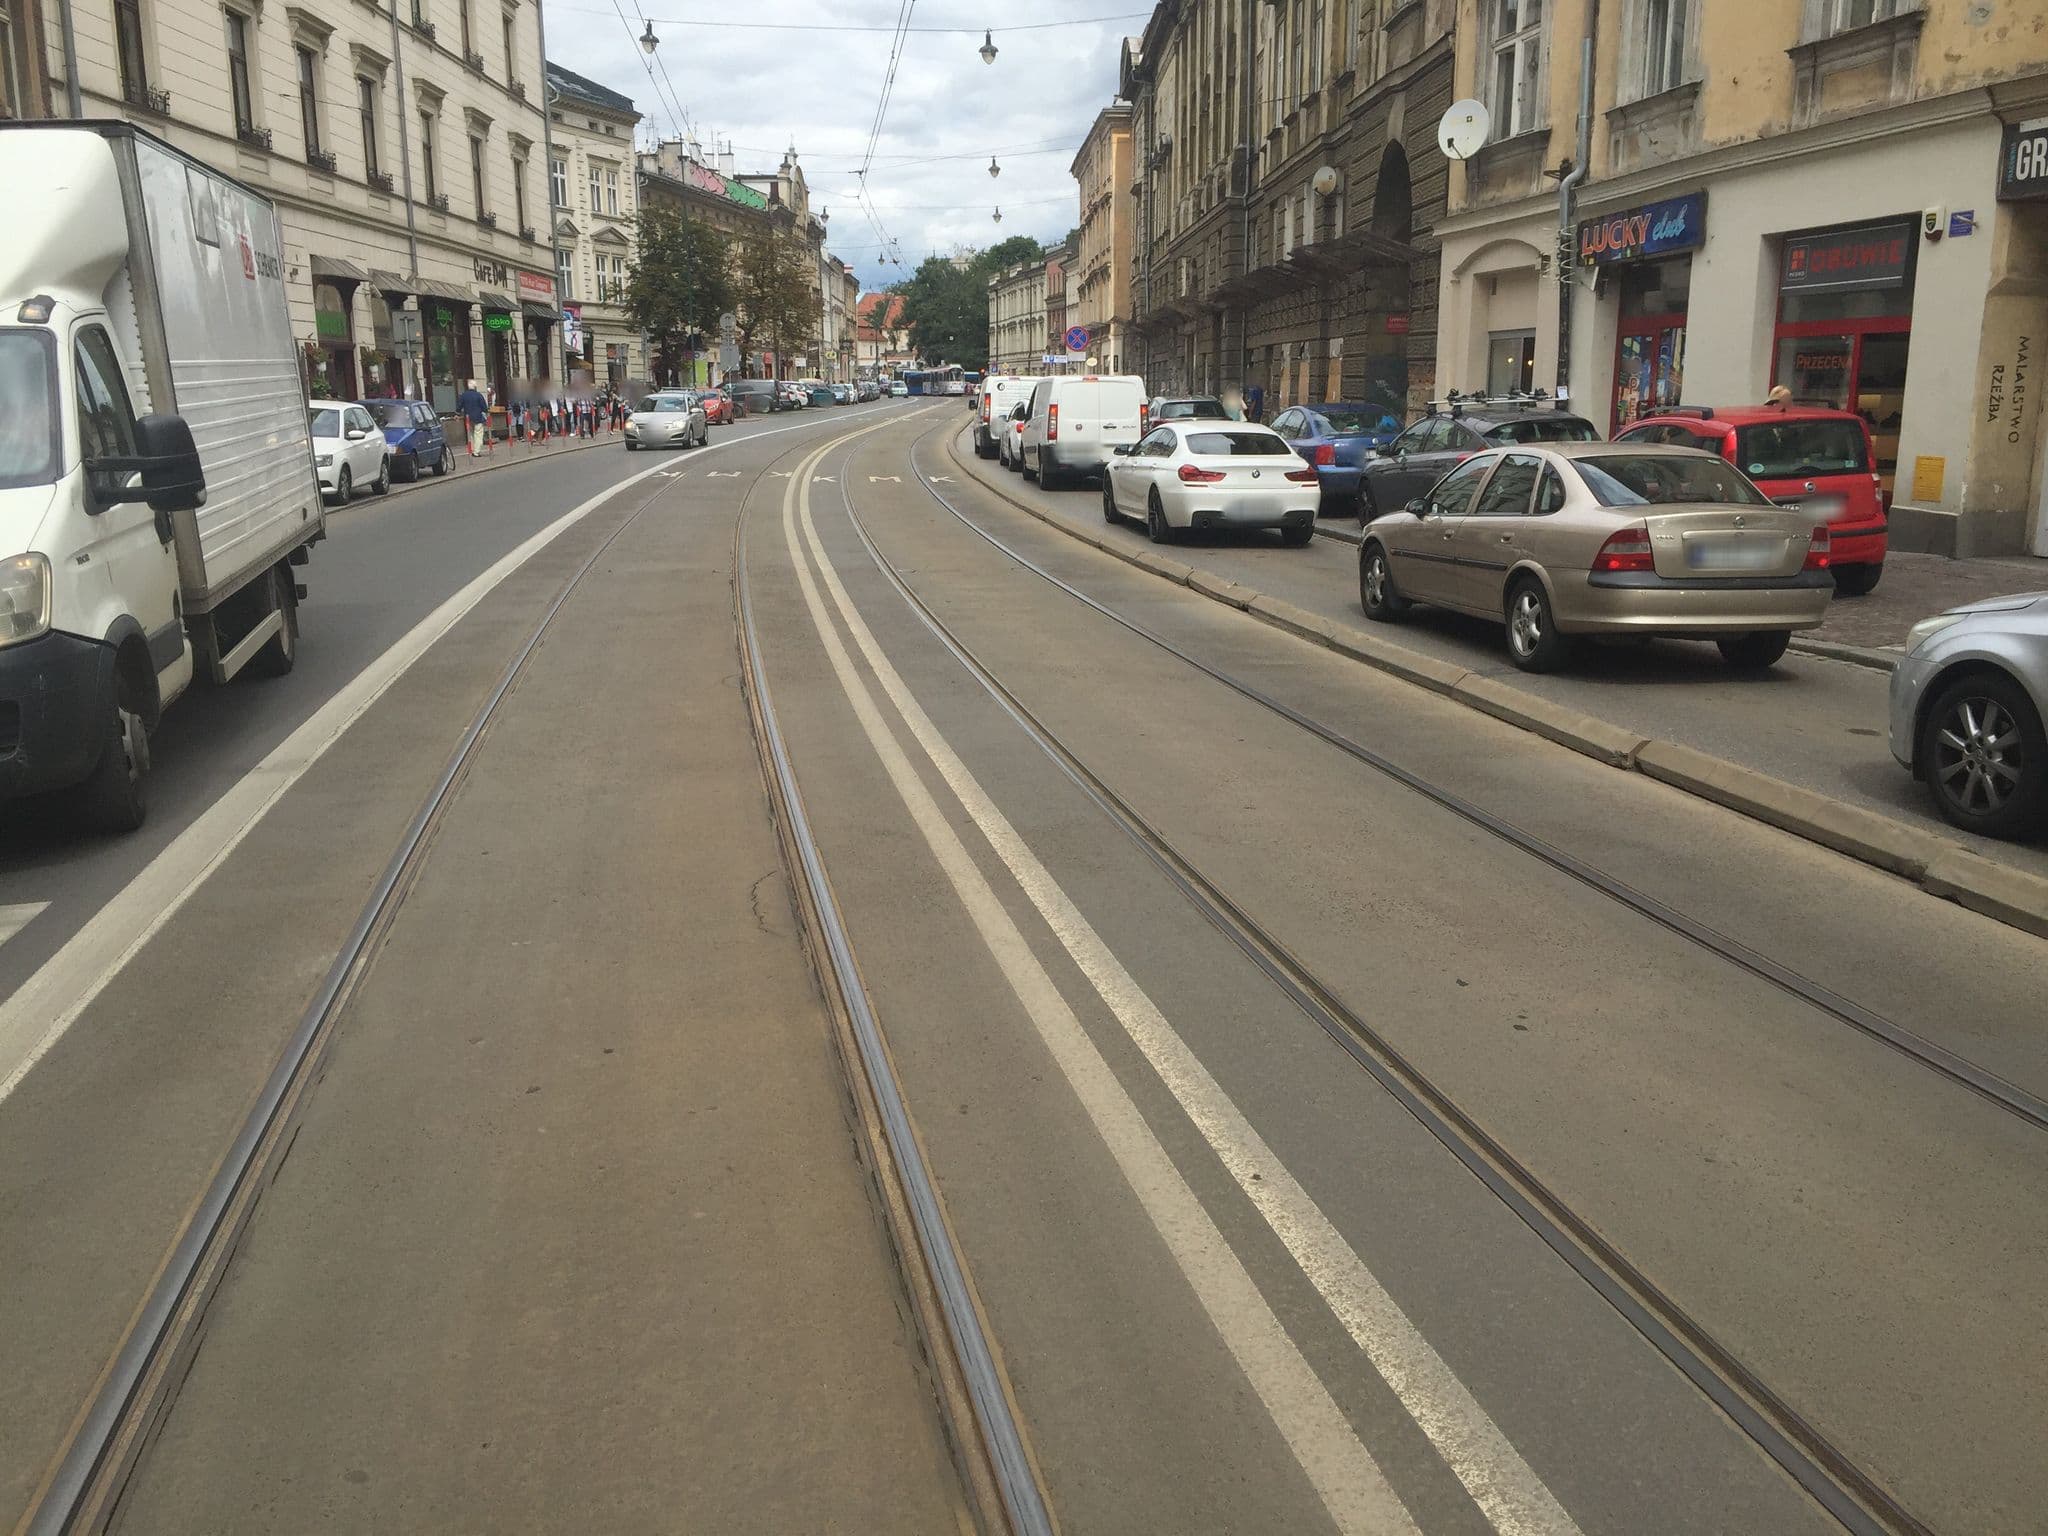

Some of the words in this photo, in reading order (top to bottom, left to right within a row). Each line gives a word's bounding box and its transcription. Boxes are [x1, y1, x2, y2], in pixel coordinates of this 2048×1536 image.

[2016, 137, 2048, 180] GR
[1581, 213, 1652, 256] LUCKY
[1811, 240, 1905, 272] OBUWIE
[1987, 365, 2005, 422] RZEŹBA
[2007, 336, 2031, 443] MALARSTWO
